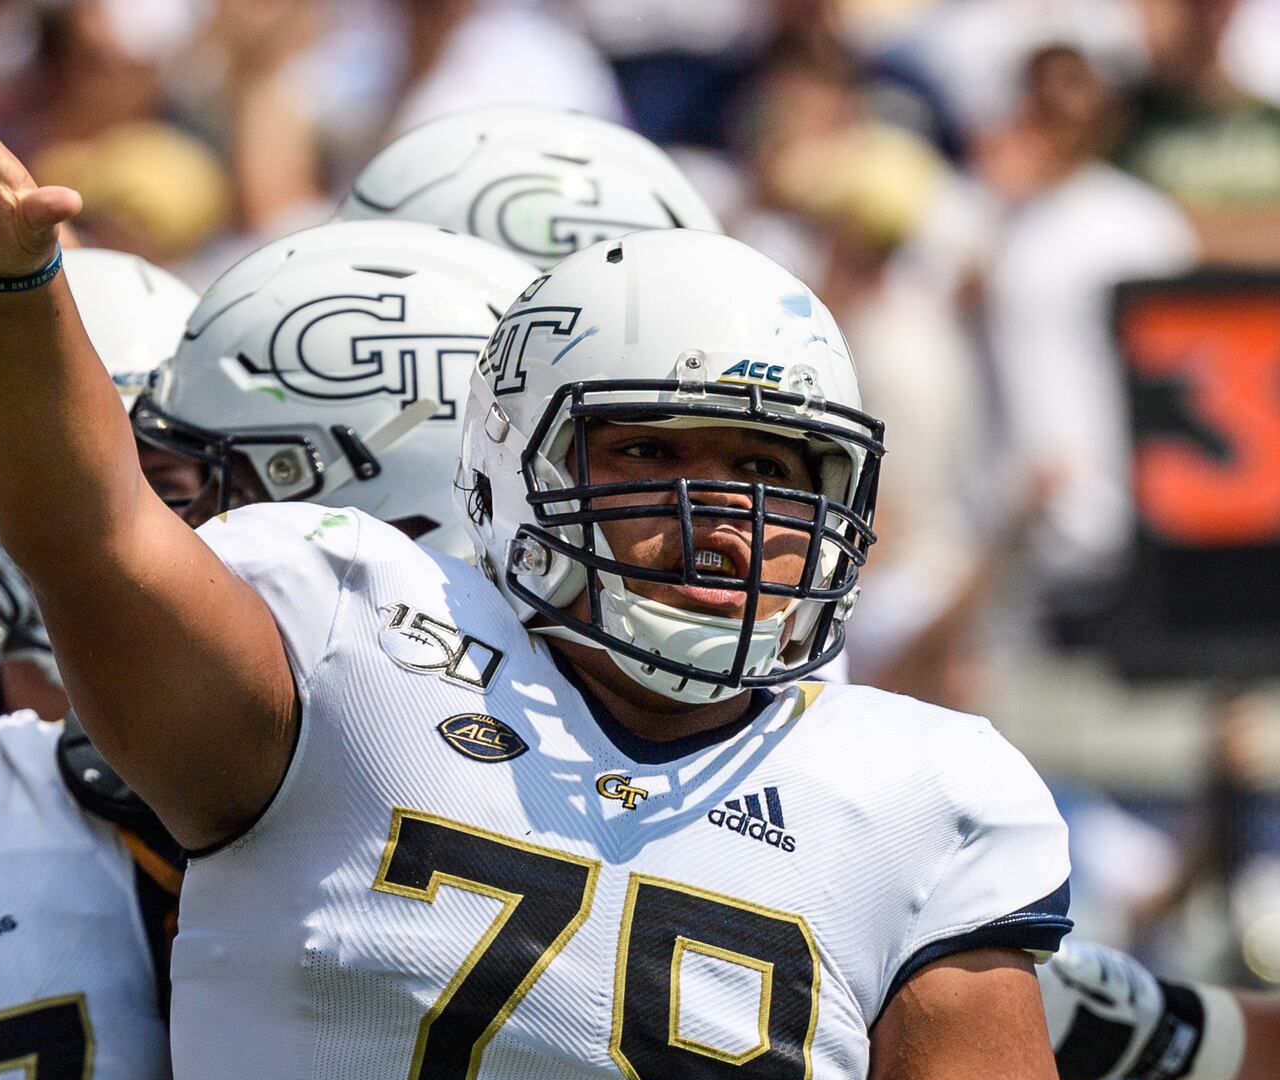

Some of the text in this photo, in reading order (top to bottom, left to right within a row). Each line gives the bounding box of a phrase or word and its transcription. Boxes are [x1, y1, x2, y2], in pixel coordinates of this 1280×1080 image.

[269, 293, 486, 422] GT
[721, 359, 786, 383] ACC
[387, 602, 505, 690] 150
[454, 722, 513, 748] ACC
[595, 773, 649, 810] GT
[707, 808, 797, 853] adidas
